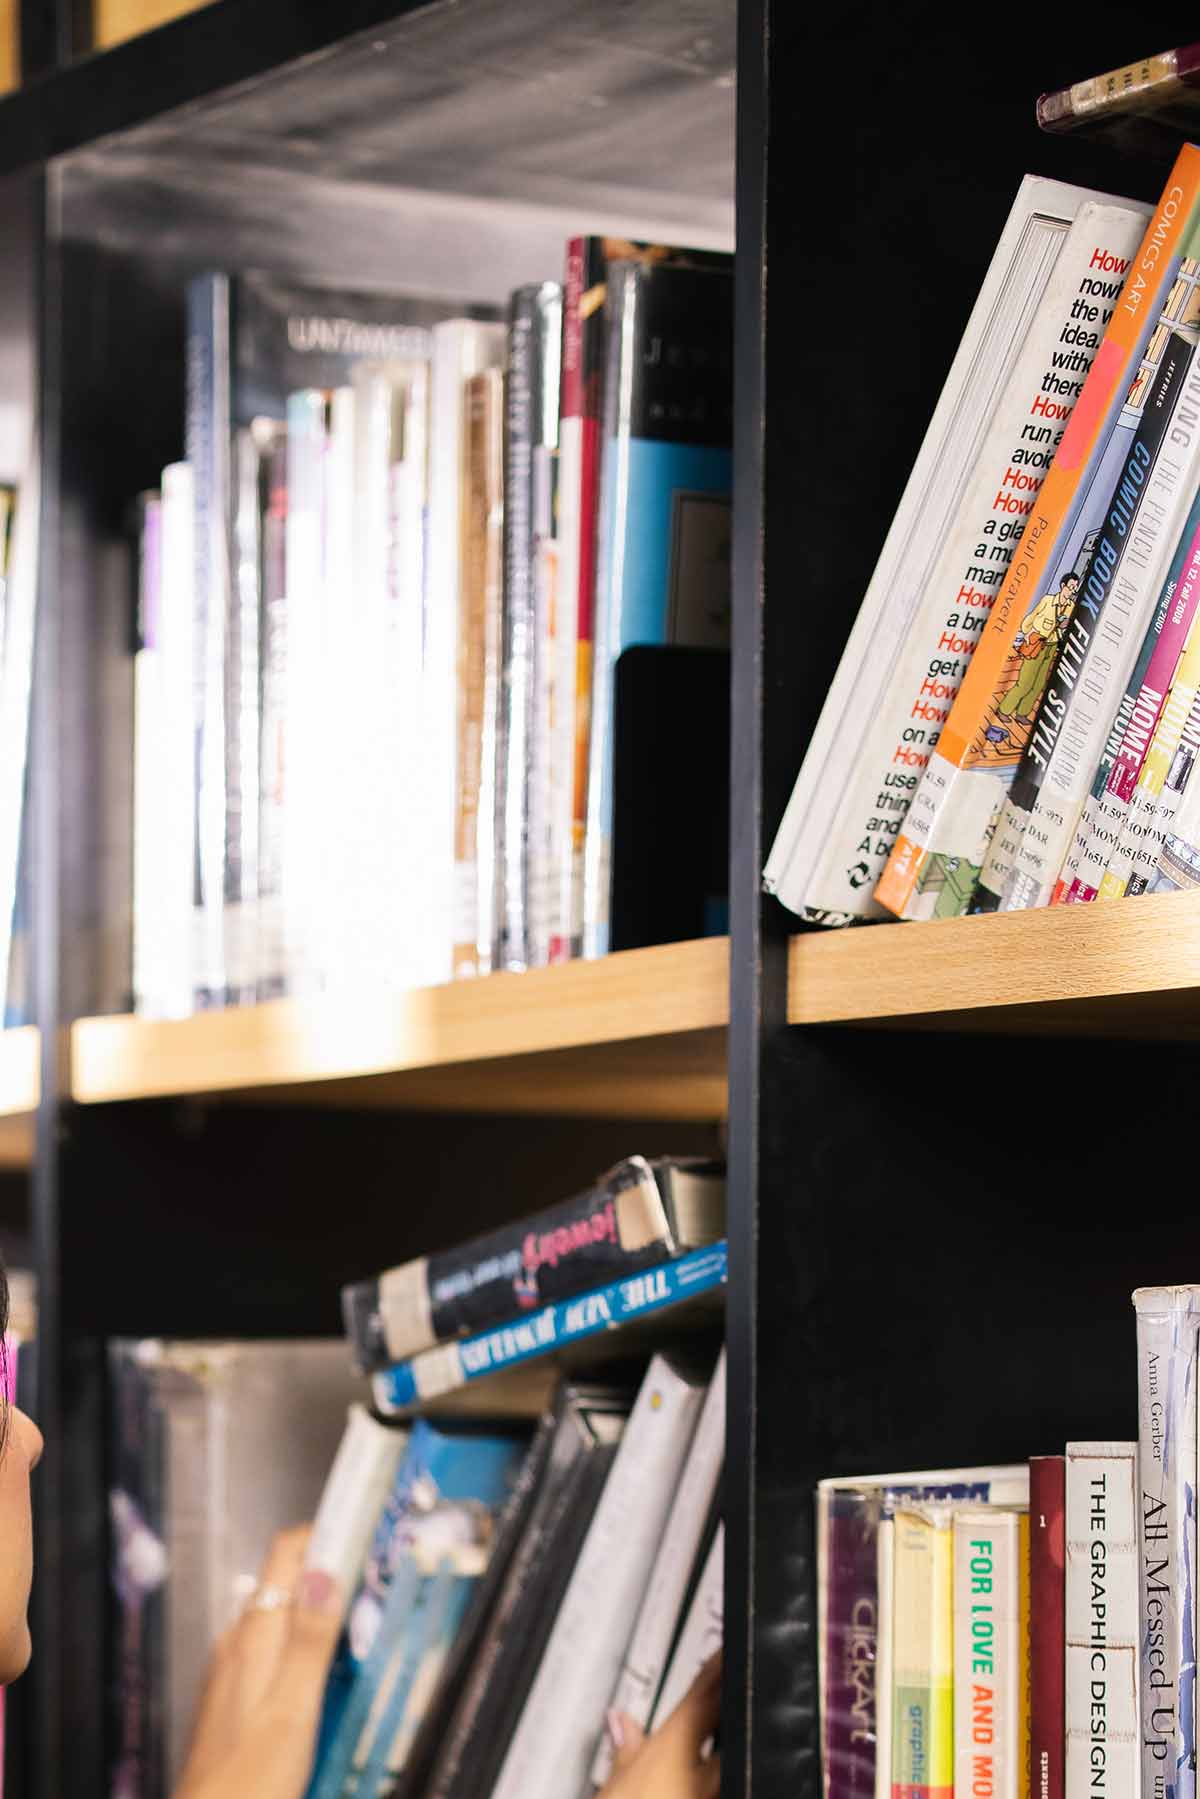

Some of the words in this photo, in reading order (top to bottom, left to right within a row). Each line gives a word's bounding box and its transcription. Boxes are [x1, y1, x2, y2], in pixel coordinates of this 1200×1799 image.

[1140, 186, 1185, 272] COMICS
[1089, 248, 1130, 275] How
[1071, 299, 1099, 322] the
[1123, 275, 1148, 318] ART
[1060, 323, 1100, 349] idea.
[1156, 360, 1176, 408] JEFFRIES
[1031, 396, 1074, 421] How
[1021, 422, 1050, 444] run
[1002, 467, 1045, 492] How
[1110, 441, 1151, 537] COMIC
[1153, 457, 1182, 497] THE
[992, 491, 1035, 516] How
[983, 520, 997, 535] a
[1019, 516, 1049, 561] Paul
[1126, 500, 1168, 569] PENCIL
[974, 544, 987, 558] a
[956, 585, 996, 609] How
[992, 561, 1030, 633] Gravett
[1083, 537, 1118, 621] BOOK
[1112, 576, 1139, 616] ART
[1161, 581, 1177, 609] Spring
[1181, 582, 1193, 600] Fall
[947, 612, 960, 627] a
[1154, 610, 1168, 635] 2007
[1172, 600, 1188, 625] 2008
[937, 631, 976, 655] How
[1057, 619, 1091, 690] FILM
[1101, 620, 1123, 648] OF
[927, 656, 961, 678] get
[1081, 655, 1112, 706] GEOF
[920, 678, 958, 701] How
[911, 700, 949, 723] How
[1028, 689, 1067, 772] STYLE
[1100, 693, 1137, 769] MOME
[1118, 683, 1163, 769] MOME
[893, 745, 930, 769] How
[902, 728, 924, 745] on
[1051, 710, 1094, 790] DARROW
[884, 772, 918, 791] use
[857, 837, 872, 854] A
[866, 815, 901, 836] and
[563, 1290, 612, 1333] NEW
[622, 1270, 671, 1312] THE
[1146, 1351, 1160, 1396] Anna
[1150, 1401, 1163, 1463] Gerber
[1090, 1473, 1106, 1531] THE
[1142, 1492, 1170, 1543] All
[969, 1540, 994, 1594] FOR
[1090, 1540, 1106, 1672] GRAPHIC
[1144, 1557, 1176, 1691] Messed
[969, 1604, 995, 1676] LOVE
[971, 1685, 993, 1745] AND
[1090, 1680, 1106, 1788] DESIGN
[1144, 1703, 1177, 1762] Up
[909, 1705, 925, 1784] graphic
